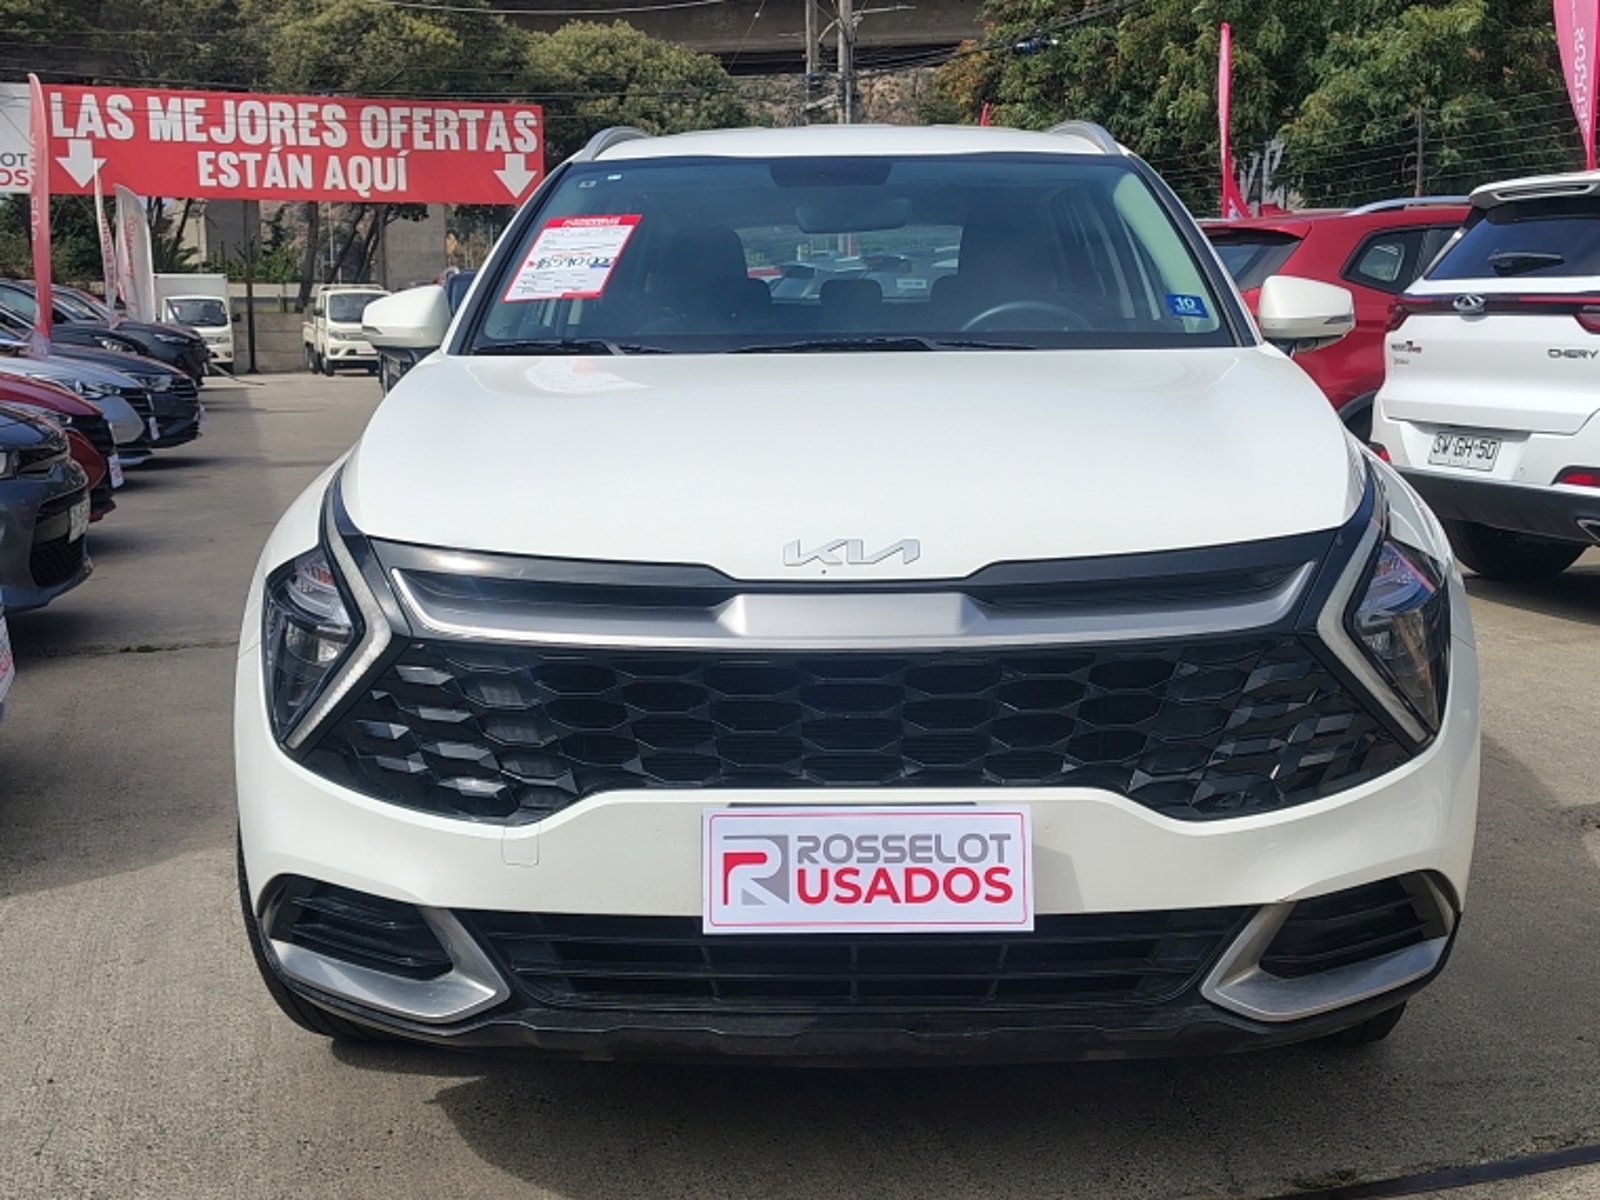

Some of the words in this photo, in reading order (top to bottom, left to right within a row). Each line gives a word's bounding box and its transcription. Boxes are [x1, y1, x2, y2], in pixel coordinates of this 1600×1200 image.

[50, 92, 135, 140] LAS
[147, 96, 348, 148] MEJORES
[360, 106, 538, 153] OFERTAS
[197, 145, 313, 189] ESTÁN
[323, 150, 411, 198] AQUÍ
[1548, 348, 1599, 359] CHERY
[797, 833, 1012, 864] ROSSELOT
[797, 866, 1014, 905] USADOS
